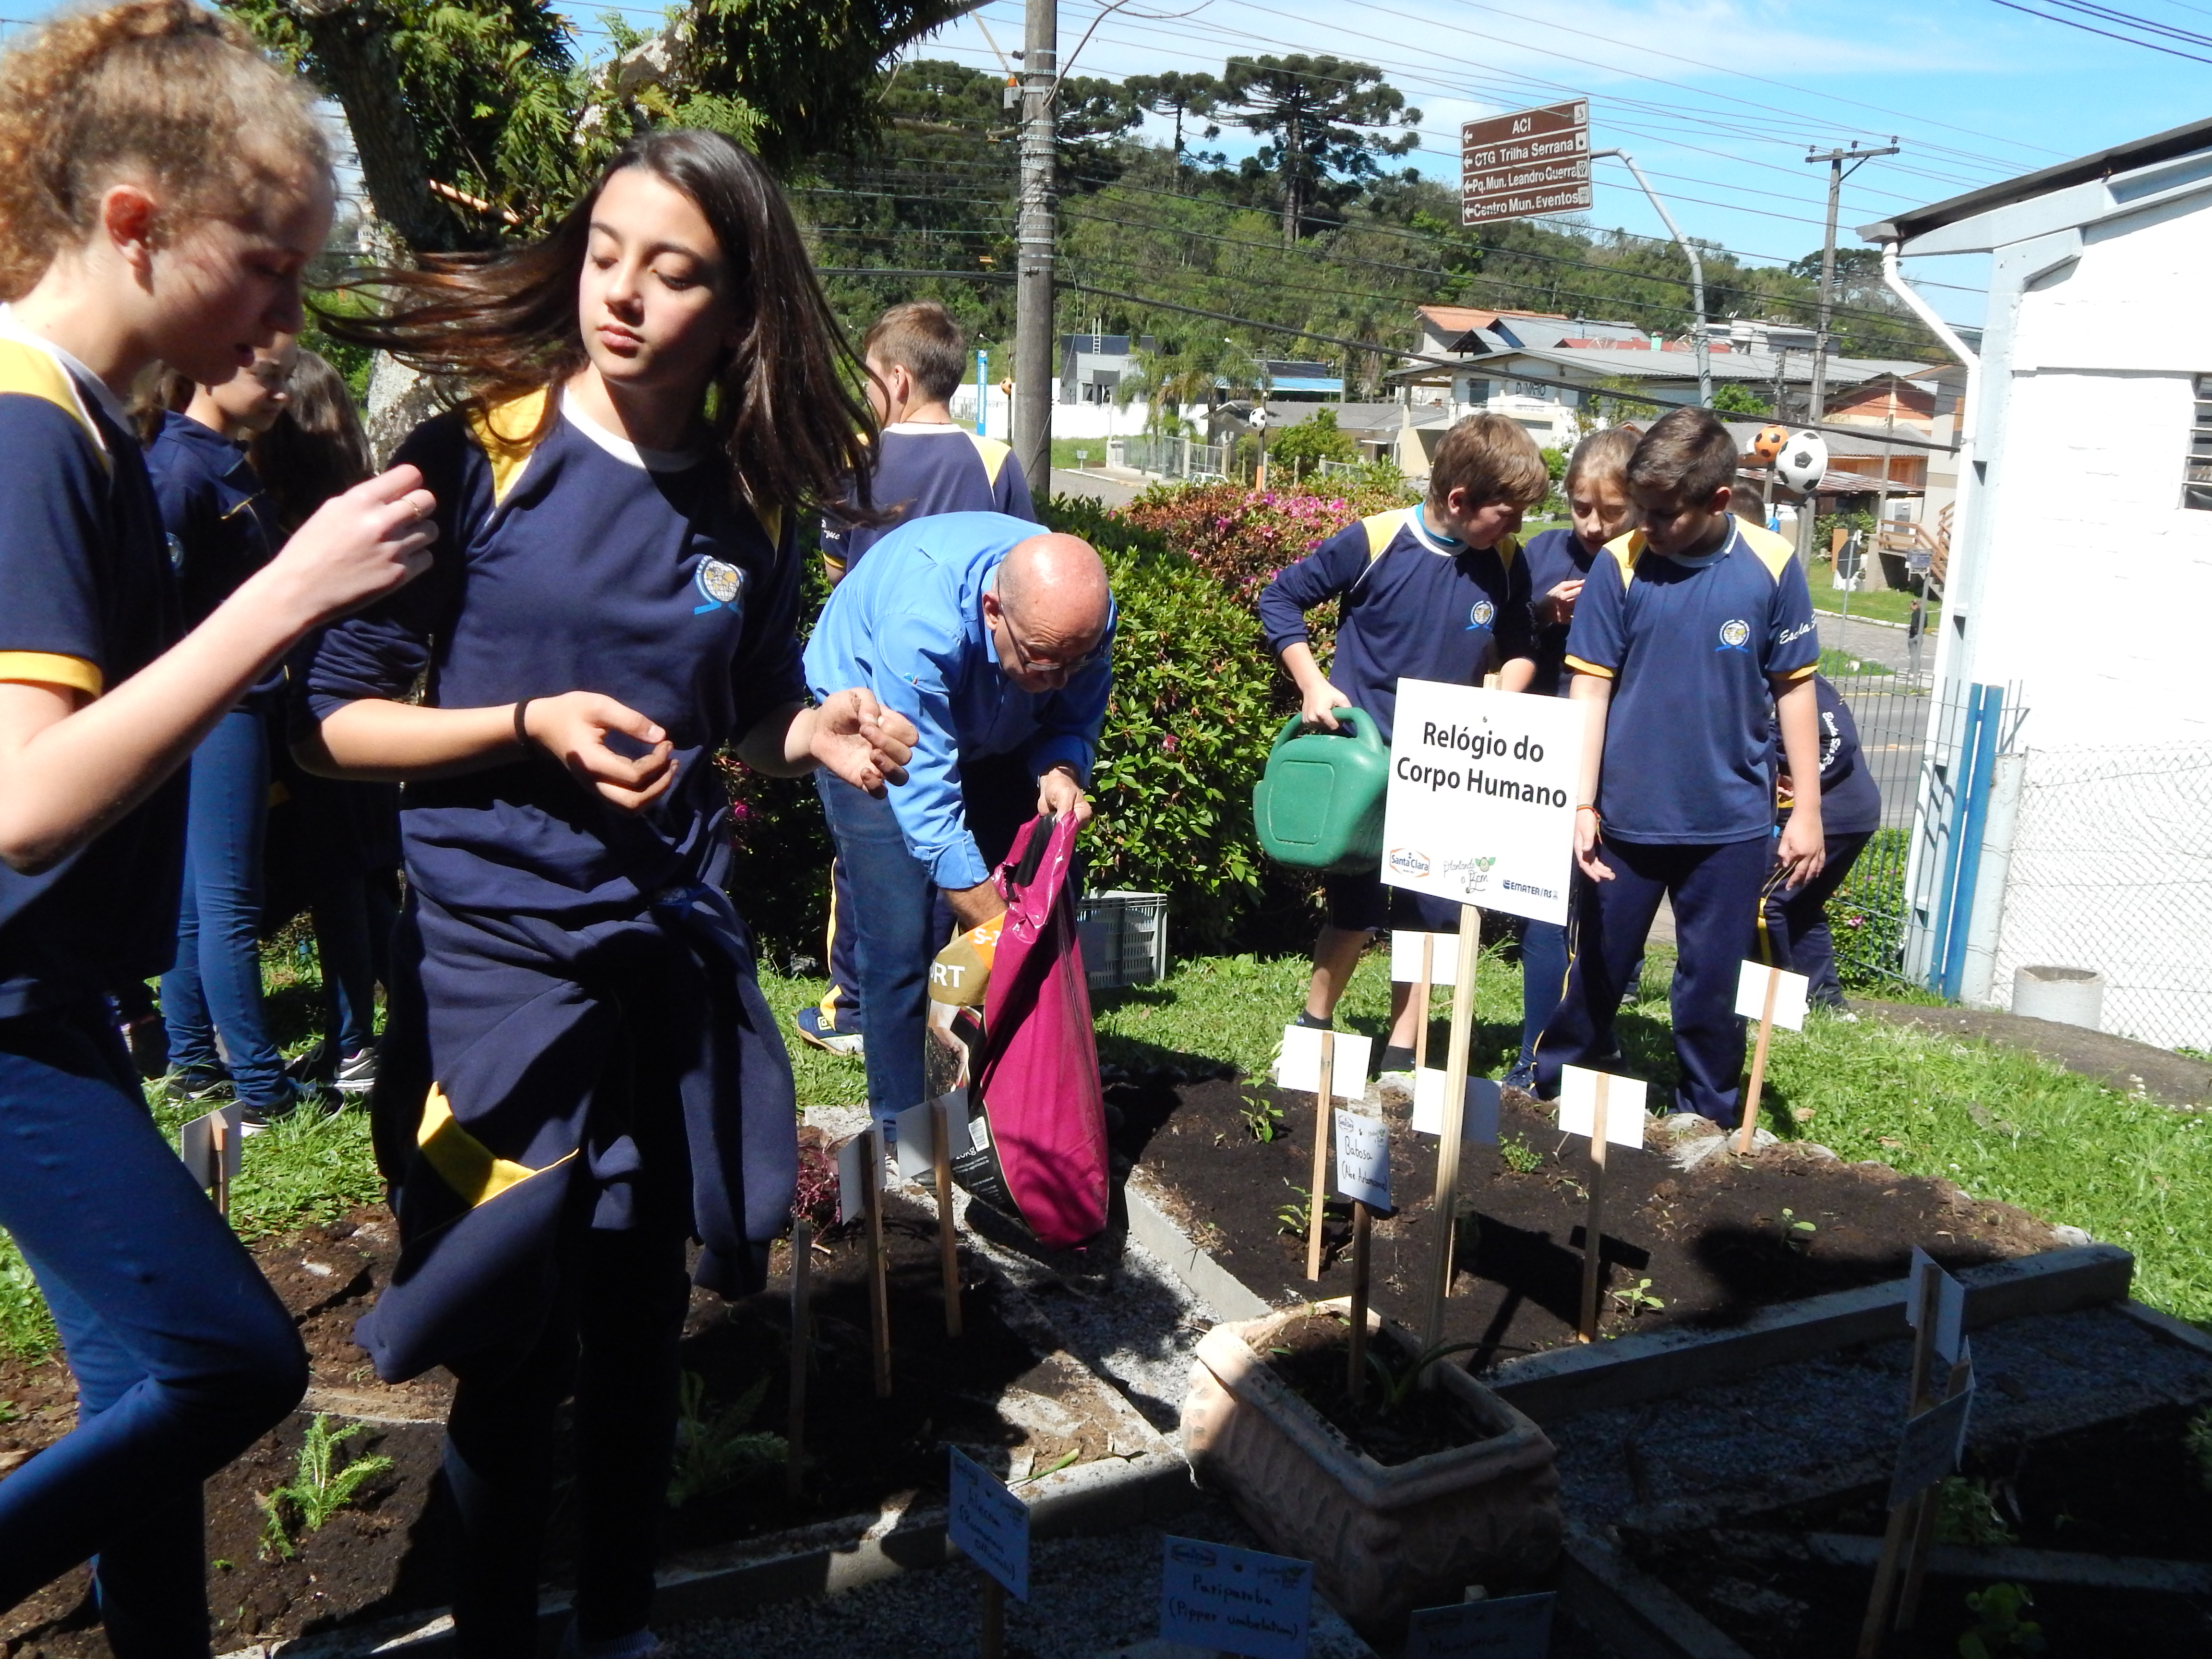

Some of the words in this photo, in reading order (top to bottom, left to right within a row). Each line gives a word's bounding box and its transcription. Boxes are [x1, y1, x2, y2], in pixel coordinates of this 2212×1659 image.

[1512, 118, 1531, 134] ACI
[1475, 151, 1496, 167] CTG
[1500, 147, 1528, 163] Trilha
[1531, 140, 1574, 156] Serrana
[1508, 170, 1545, 187] Leandro
[1545, 166, 1577, 180] Guerra
[1473, 202, 1507, 217] Centro
[1536, 192, 1579, 207] Eventos
[1423, 721, 1507, 759] Relógio
[1514, 735, 1544, 762] do
[1397, 757, 1460, 792] Corpo
[1467, 768, 1567, 807] Humano
[1391, 854, 1410, 866] Santa
[1411, 858, 1429, 871] Clara
[1511, 882, 1552, 898] EMATER/RS
[1345, 1135, 1372, 1160] Babosa
[1193, 1574, 1273, 1606] Pariparoba
